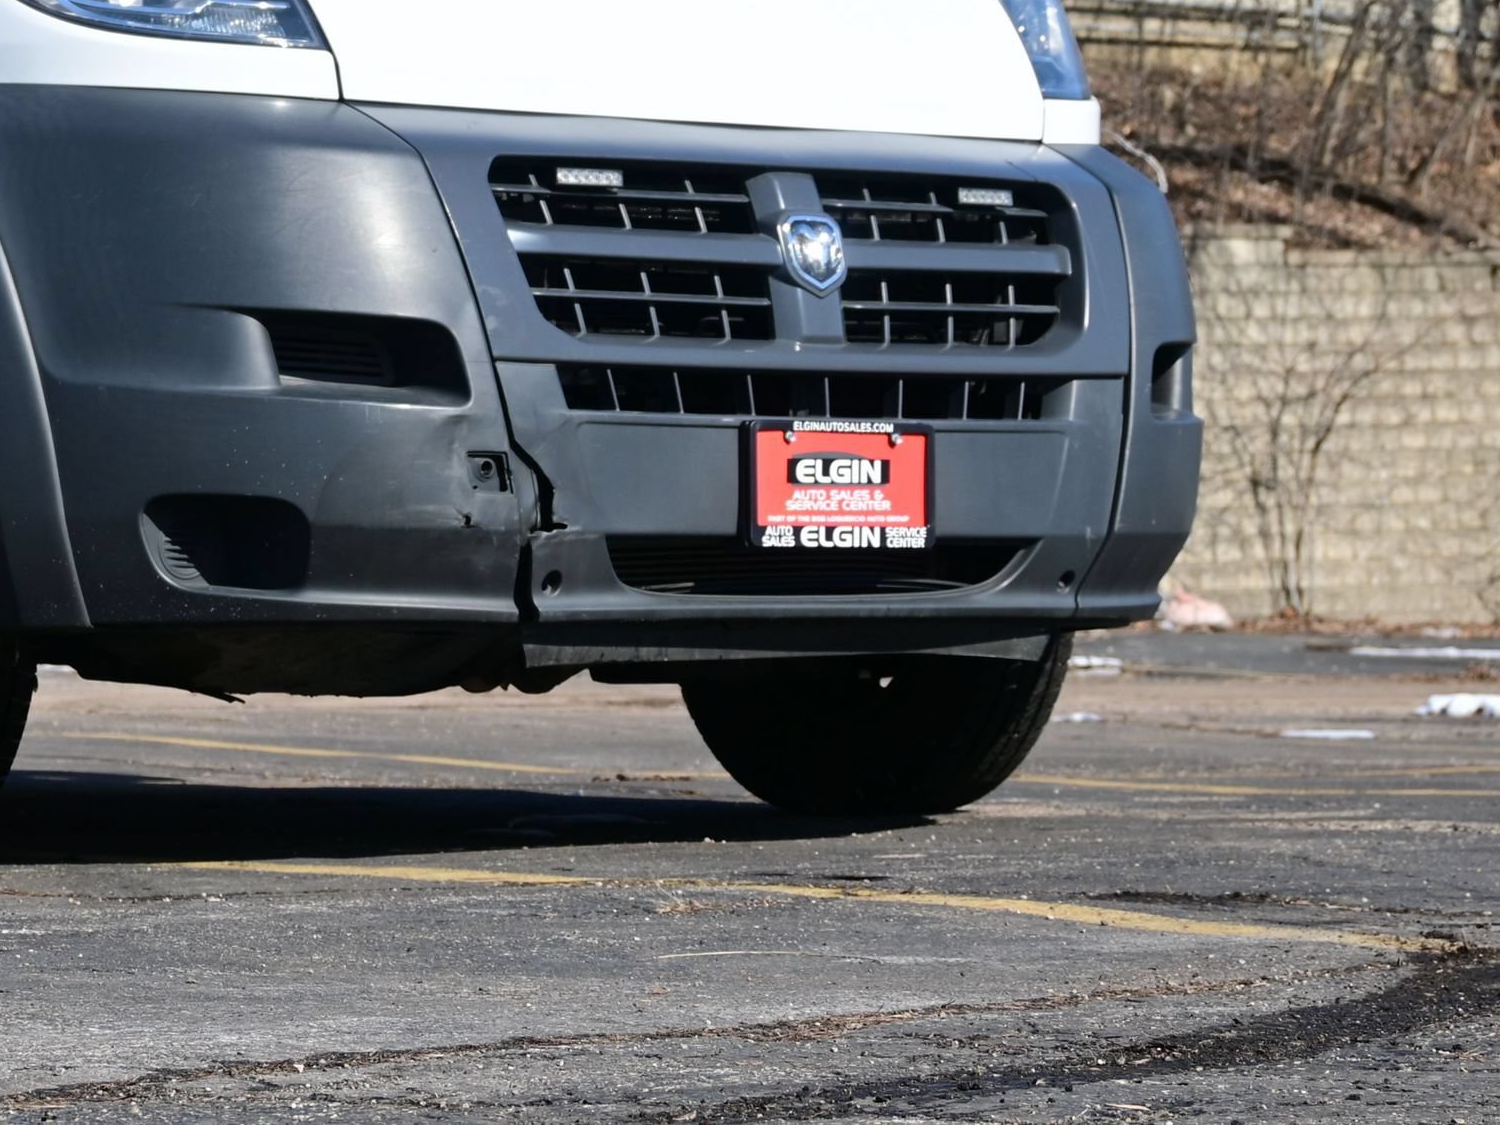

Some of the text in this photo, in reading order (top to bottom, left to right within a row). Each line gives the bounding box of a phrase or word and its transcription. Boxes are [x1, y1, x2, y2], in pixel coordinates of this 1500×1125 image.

[792, 420, 894, 432] ELGINAUTOSALES.COM
[795, 459, 882, 484] ELGIN
[792, 489, 884, 501] AUTO SALES &
[785, 500, 892, 511] SERVICE CENTER
[765, 526, 793, 536] AUTO
[885, 527, 927, 538] SERVICE
[761, 536, 796, 547] SALES
[800, 526, 881, 548] ELGIN
[886, 537, 926, 548] CENTER
